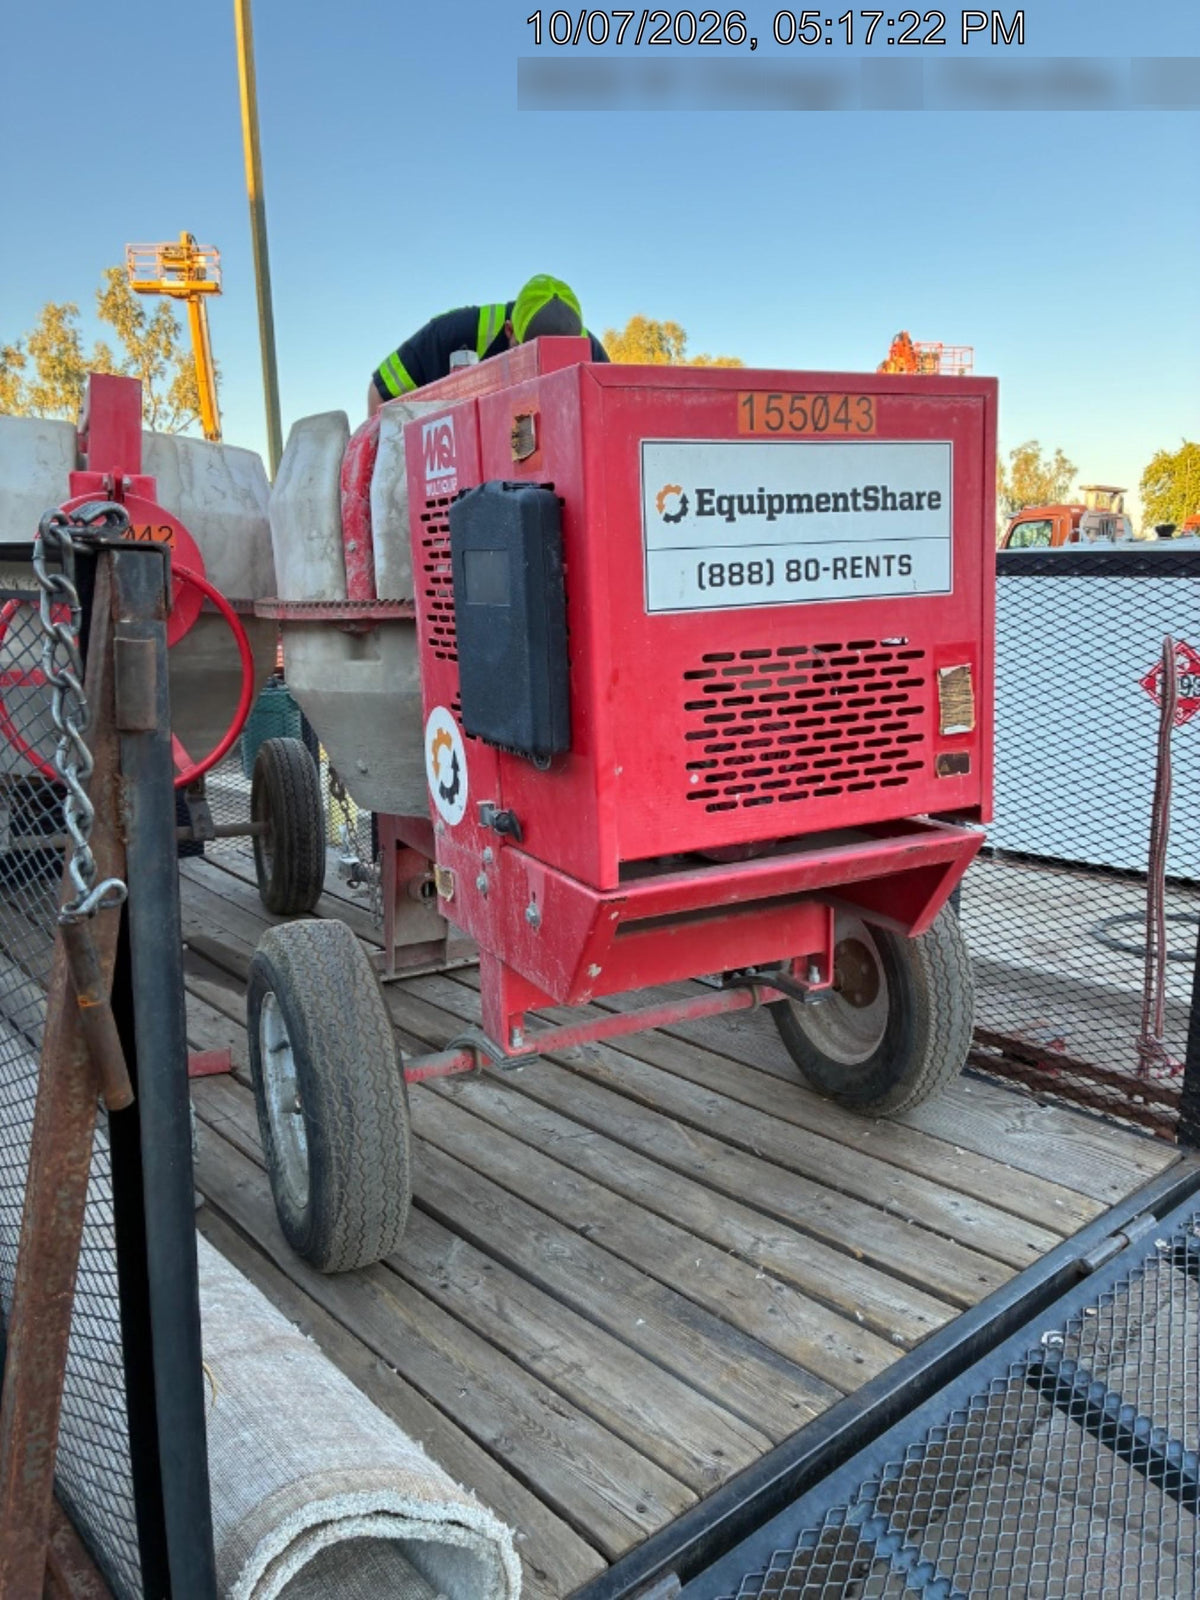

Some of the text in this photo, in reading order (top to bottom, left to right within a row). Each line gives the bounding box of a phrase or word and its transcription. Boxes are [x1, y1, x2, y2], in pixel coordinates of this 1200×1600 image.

[742, 394, 874, 432] 155043
[695, 485, 942, 522] EquipmentShare
[697, 554, 912, 590] (888) 80-RENTS
